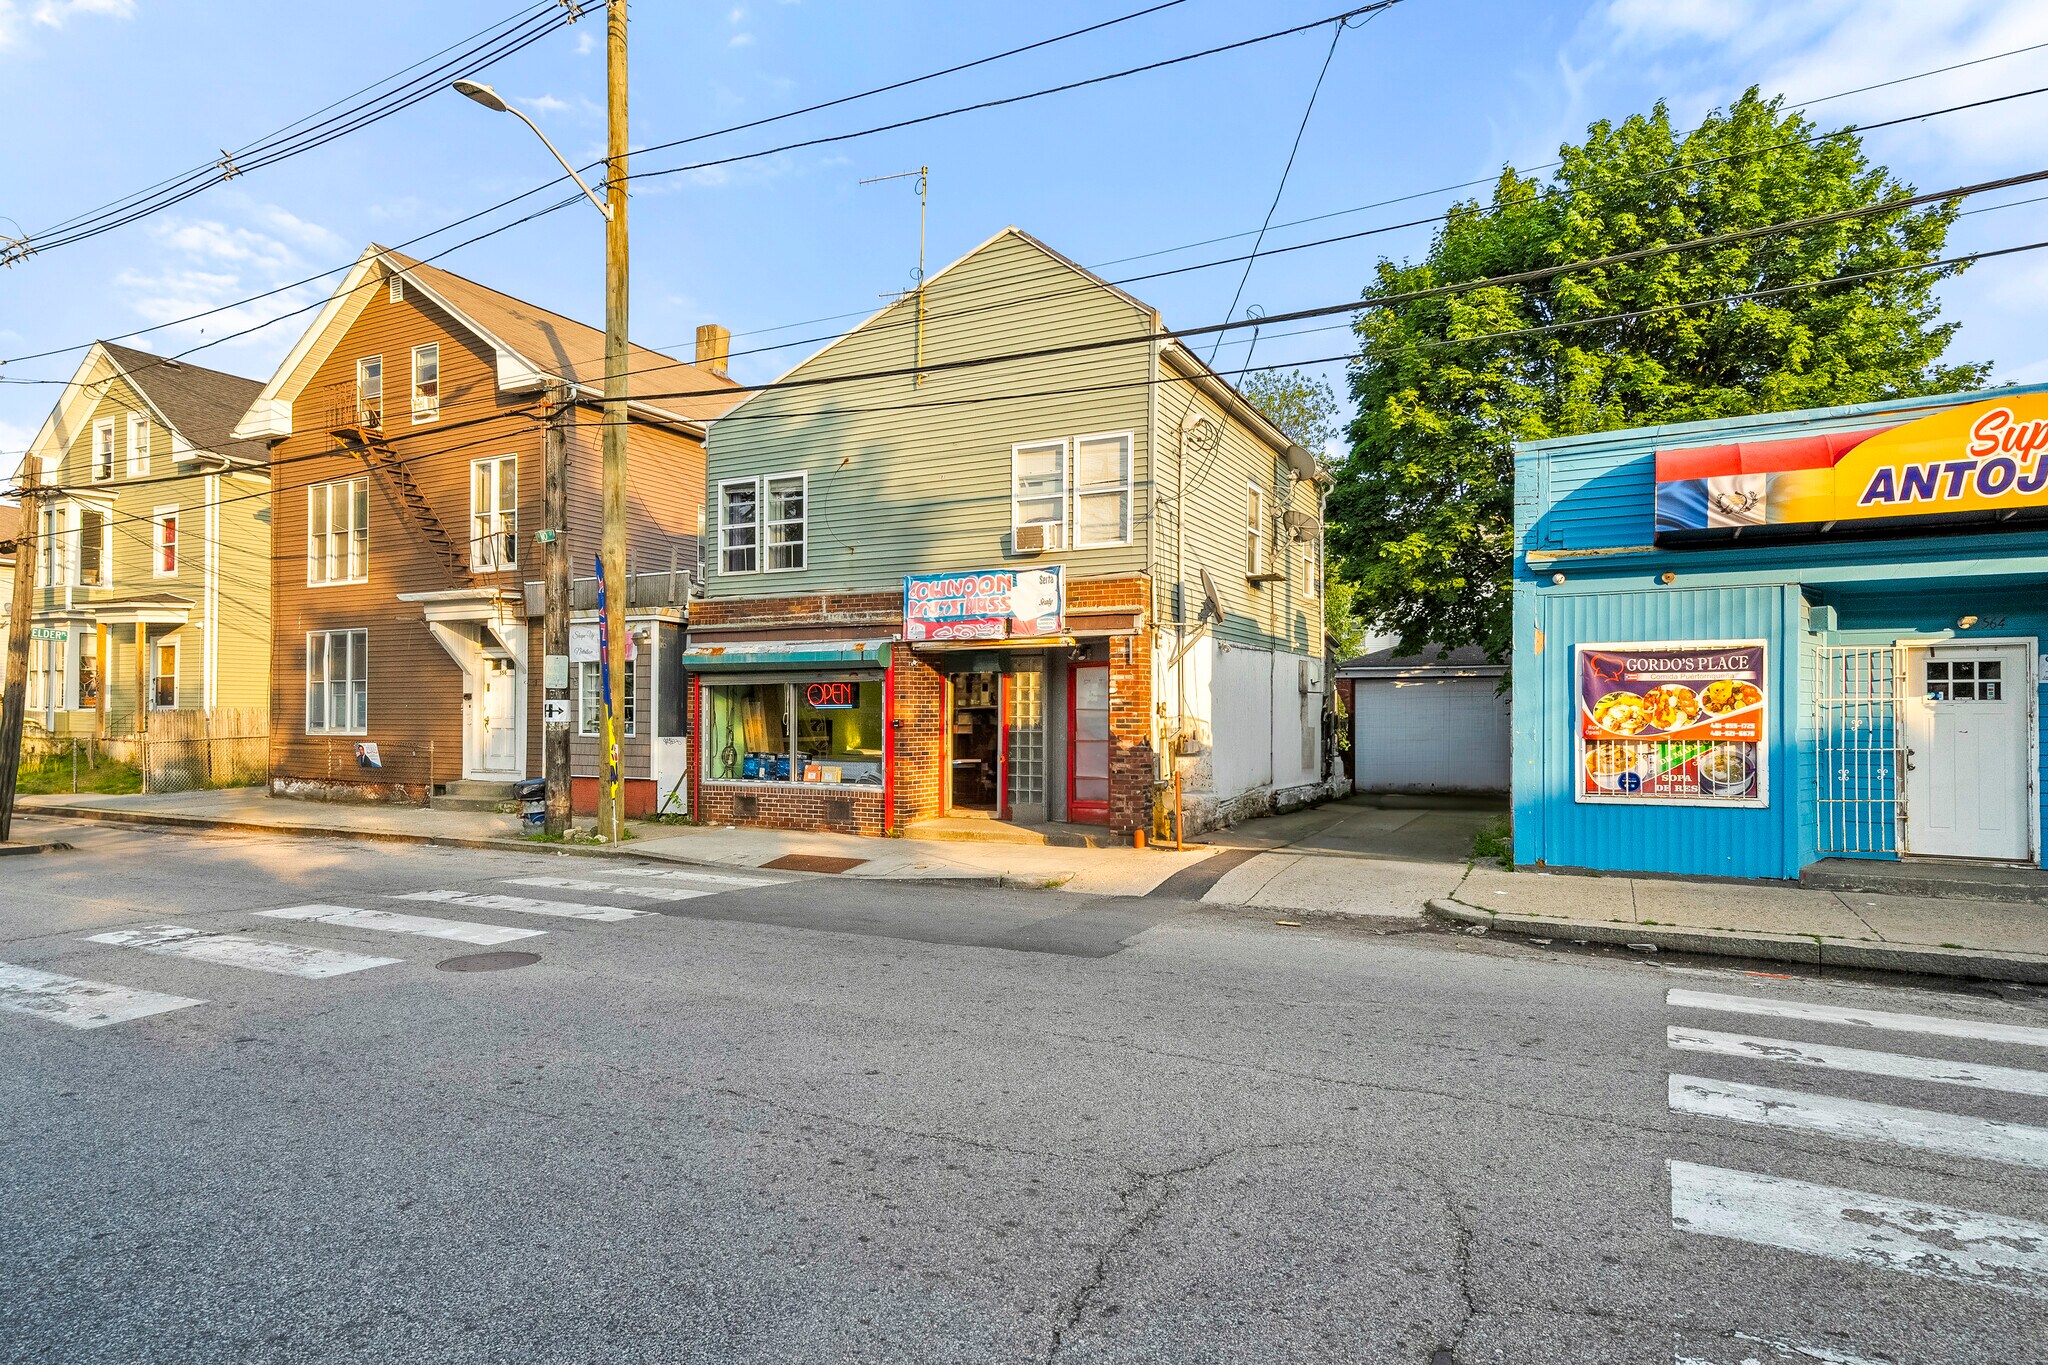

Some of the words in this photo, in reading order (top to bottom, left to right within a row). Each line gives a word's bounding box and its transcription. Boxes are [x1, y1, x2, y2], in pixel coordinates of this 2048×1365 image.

[1970, 410, 2048, 463] Sup
[1860, 454, 2048, 505] ANTOJ
[1039, 575, 1054, 585] Serta
[1981, 616, 2006, 630] 564
[32, 628, 61, 640] ELDER
[1626, 657, 1695, 672] GORDO'S
[1697, 655, 1749, 671] PLACE
[1680, 672, 1735, 681] Puertorriqueña
[807, 683, 852, 705] OPEN
[1661, 774, 1692, 782] SOPA
[1655, 784, 1671, 793] DE
[1674, 784, 1699, 793] RES
